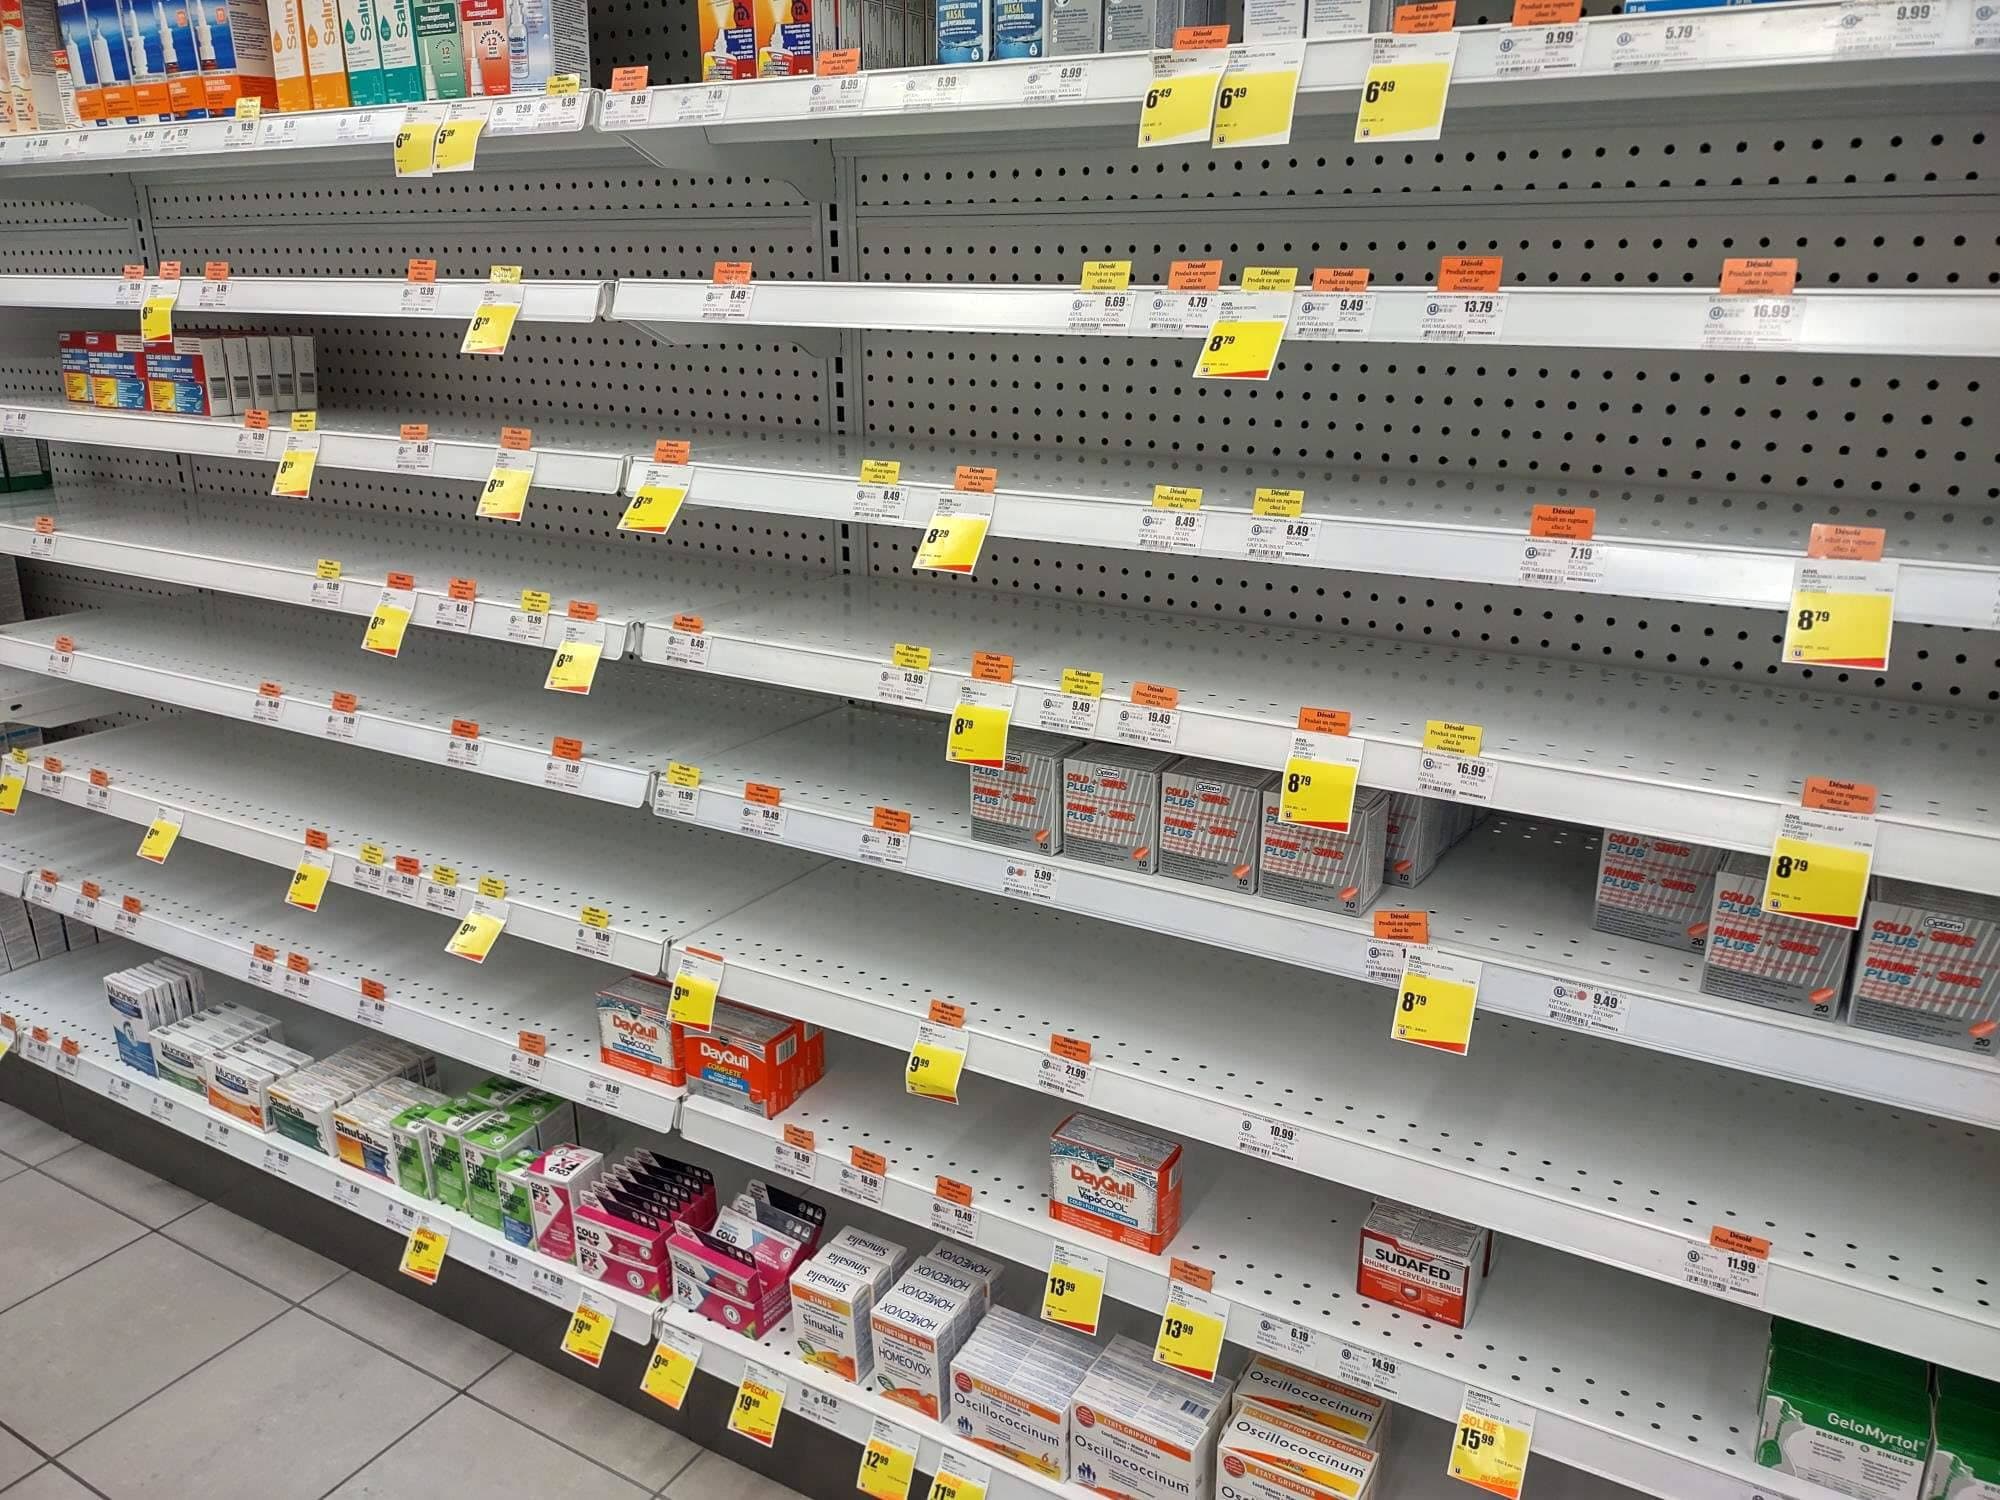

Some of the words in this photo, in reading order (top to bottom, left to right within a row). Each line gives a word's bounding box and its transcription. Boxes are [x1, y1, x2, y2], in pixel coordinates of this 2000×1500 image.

[1896, 4, 1930, 21] 9.99
[1665, 25, 1694, 40] 5.79
[1060, 67, 1082, 79] 9.99
[840, 79, 859, 91] 8.99
[937, 76, 957, 88] 6.99
[730, 290, 746, 301] 8.49
[1104, 296, 1125, 308] 6.69
[1188, 297, 1208, 308] 4.79
[1340, 300, 1364, 311] 9.49
[1464, 301, 1493, 313] 13.79
[1753, 305, 1790, 318] 16.99
[883, 490, 900, 501] 8.49
[1175, 516, 1195, 527] 8.49
[1286, 524, 1309, 537] 8.49
[1570, 546, 1593, 560] 7.19
[690, 638, 704, 649] 8.49
[904, 673, 923, 685] 13.99
[1071, 700, 1090, 712] 9.49
[1148, 711, 1170, 725] 19.49
[1444, 723, 1464, 731] Désolé
[565, 763, 580, 774] 11.99
[973, 765, 999, 776] PLUS
[1456, 761, 1486, 777] 16.99
[677, 789, 693, 800] 11.99
[1066, 782, 1095, 793] PLUS
[973, 795, 998, 805] PLUS
[1165, 796, 1195, 808] PLUS
[762, 809, 780, 821] 19.49
[1067, 812, 1094, 822] PLUS
[1163, 825, 1193, 838] PLUS
[886, 835, 901, 848] 7.19
[1264, 846, 1296, 859] PLUS
[1606, 843, 1645, 858] PLUS
[1034, 869, 1052, 881] 5.99
[1238, 878, 1248, 886] 10
[1602, 876, 1641, 891] PLUS
[1345, 901, 1355, 909] 10
[1717, 901, 1761, 917] PLUS
[1691, 937, 1704, 946] 20
[1713, 936, 1755, 953] PLUS
[1871, 932, 1919, 948] PLUS
[1864, 968, 1912, 985] PLUS
[106, 984, 138, 1005] Mucinex
[1593, 993, 1618, 1008] 9.49
[1814, 1003, 1829, 1013] 20
[612, 1015, 658, 1040] DayQuil
[161, 1042, 190, 1064] Mucinex
[700, 1042, 749, 1069] DayQuil
[215, 1066, 247, 1087] Mucinex
[707, 1062, 742, 1078] COMPLETE
[1065, 1064, 1087, 1081] 21.99
[269, 1096, 304, 1118] Sinutab
[336, 1121, 372, 1144] Sinutab
[1269, 1124, 1295, 1141] 10.99
[794, 1152, 810, 1164] 18.99
[531, 1182, 549, 1193] COLD
[861, 1175, 877, 1187] 18.99
[1071, 1164, 1135, 1198] DayQuil
[954, 1209, 972, 1222] 13.49
[576, 1226, 600, 1240] COLD
[716, 1229, 737, 1245] COLD
[848, 1234, 889, 1256] Sinusalia
[580, 1247, 598, 1259] COLD
[827, 1252, 871, 1276] Sinusalia
[936, 1248, 992, 1277] HOMEOVOX
[1375, 1248, 1452, 1280] SUDAFED
[1727, 1256, 1756, 1274] 11.99
[806, 1270, 850, 1293] Sinusalia
[914, 1264, 970, 1292] HOMEOVOX
[1364, 1258, 1389, 1271] RHUME
[1398, 1269, 1430, 1284] CERVEAU
[1439, 1282, 1461, 1293] SINUS
[898, 1283, 955, 1312] HOMEOVOX
[577, 1306, 600, 1323] SPECIAL
[880, 1302, 938, 1331] HOMEOVOX
[803, 1314, 844, 1339] Sinusalia
[1291, 1327, 1309, 1342] 6.19
[879, 1346, 931, 1377] HOMEOVOX
[1372, 1356, 1396, 1374] 14.99
[743, 1381, 769, 1399] SPECIAL
[1250, 1371, 1373, 1422] Oscillococcinum
[821, 1394, 837, 1408] 15.49
[955, 1393, 1059, 1446] Oscillococcinum
[1462, 1414, 1497, 1434] SOLDE
[1827, 1412, 1919, 1452] GeloMyrtol
[1237, 1421, 1365, 1478] Oscillococcinum
[1816, 1431, 1854, 1446] BRONCHI
[1877, 1450, 1914, 1466] SINUSES
[1041, 1453, 1049, 1463] 6
[1075, 1434, 1189, 1494] Oscillococcinum
[1278, 1477, 1316, 1498] GRIPPAUX
